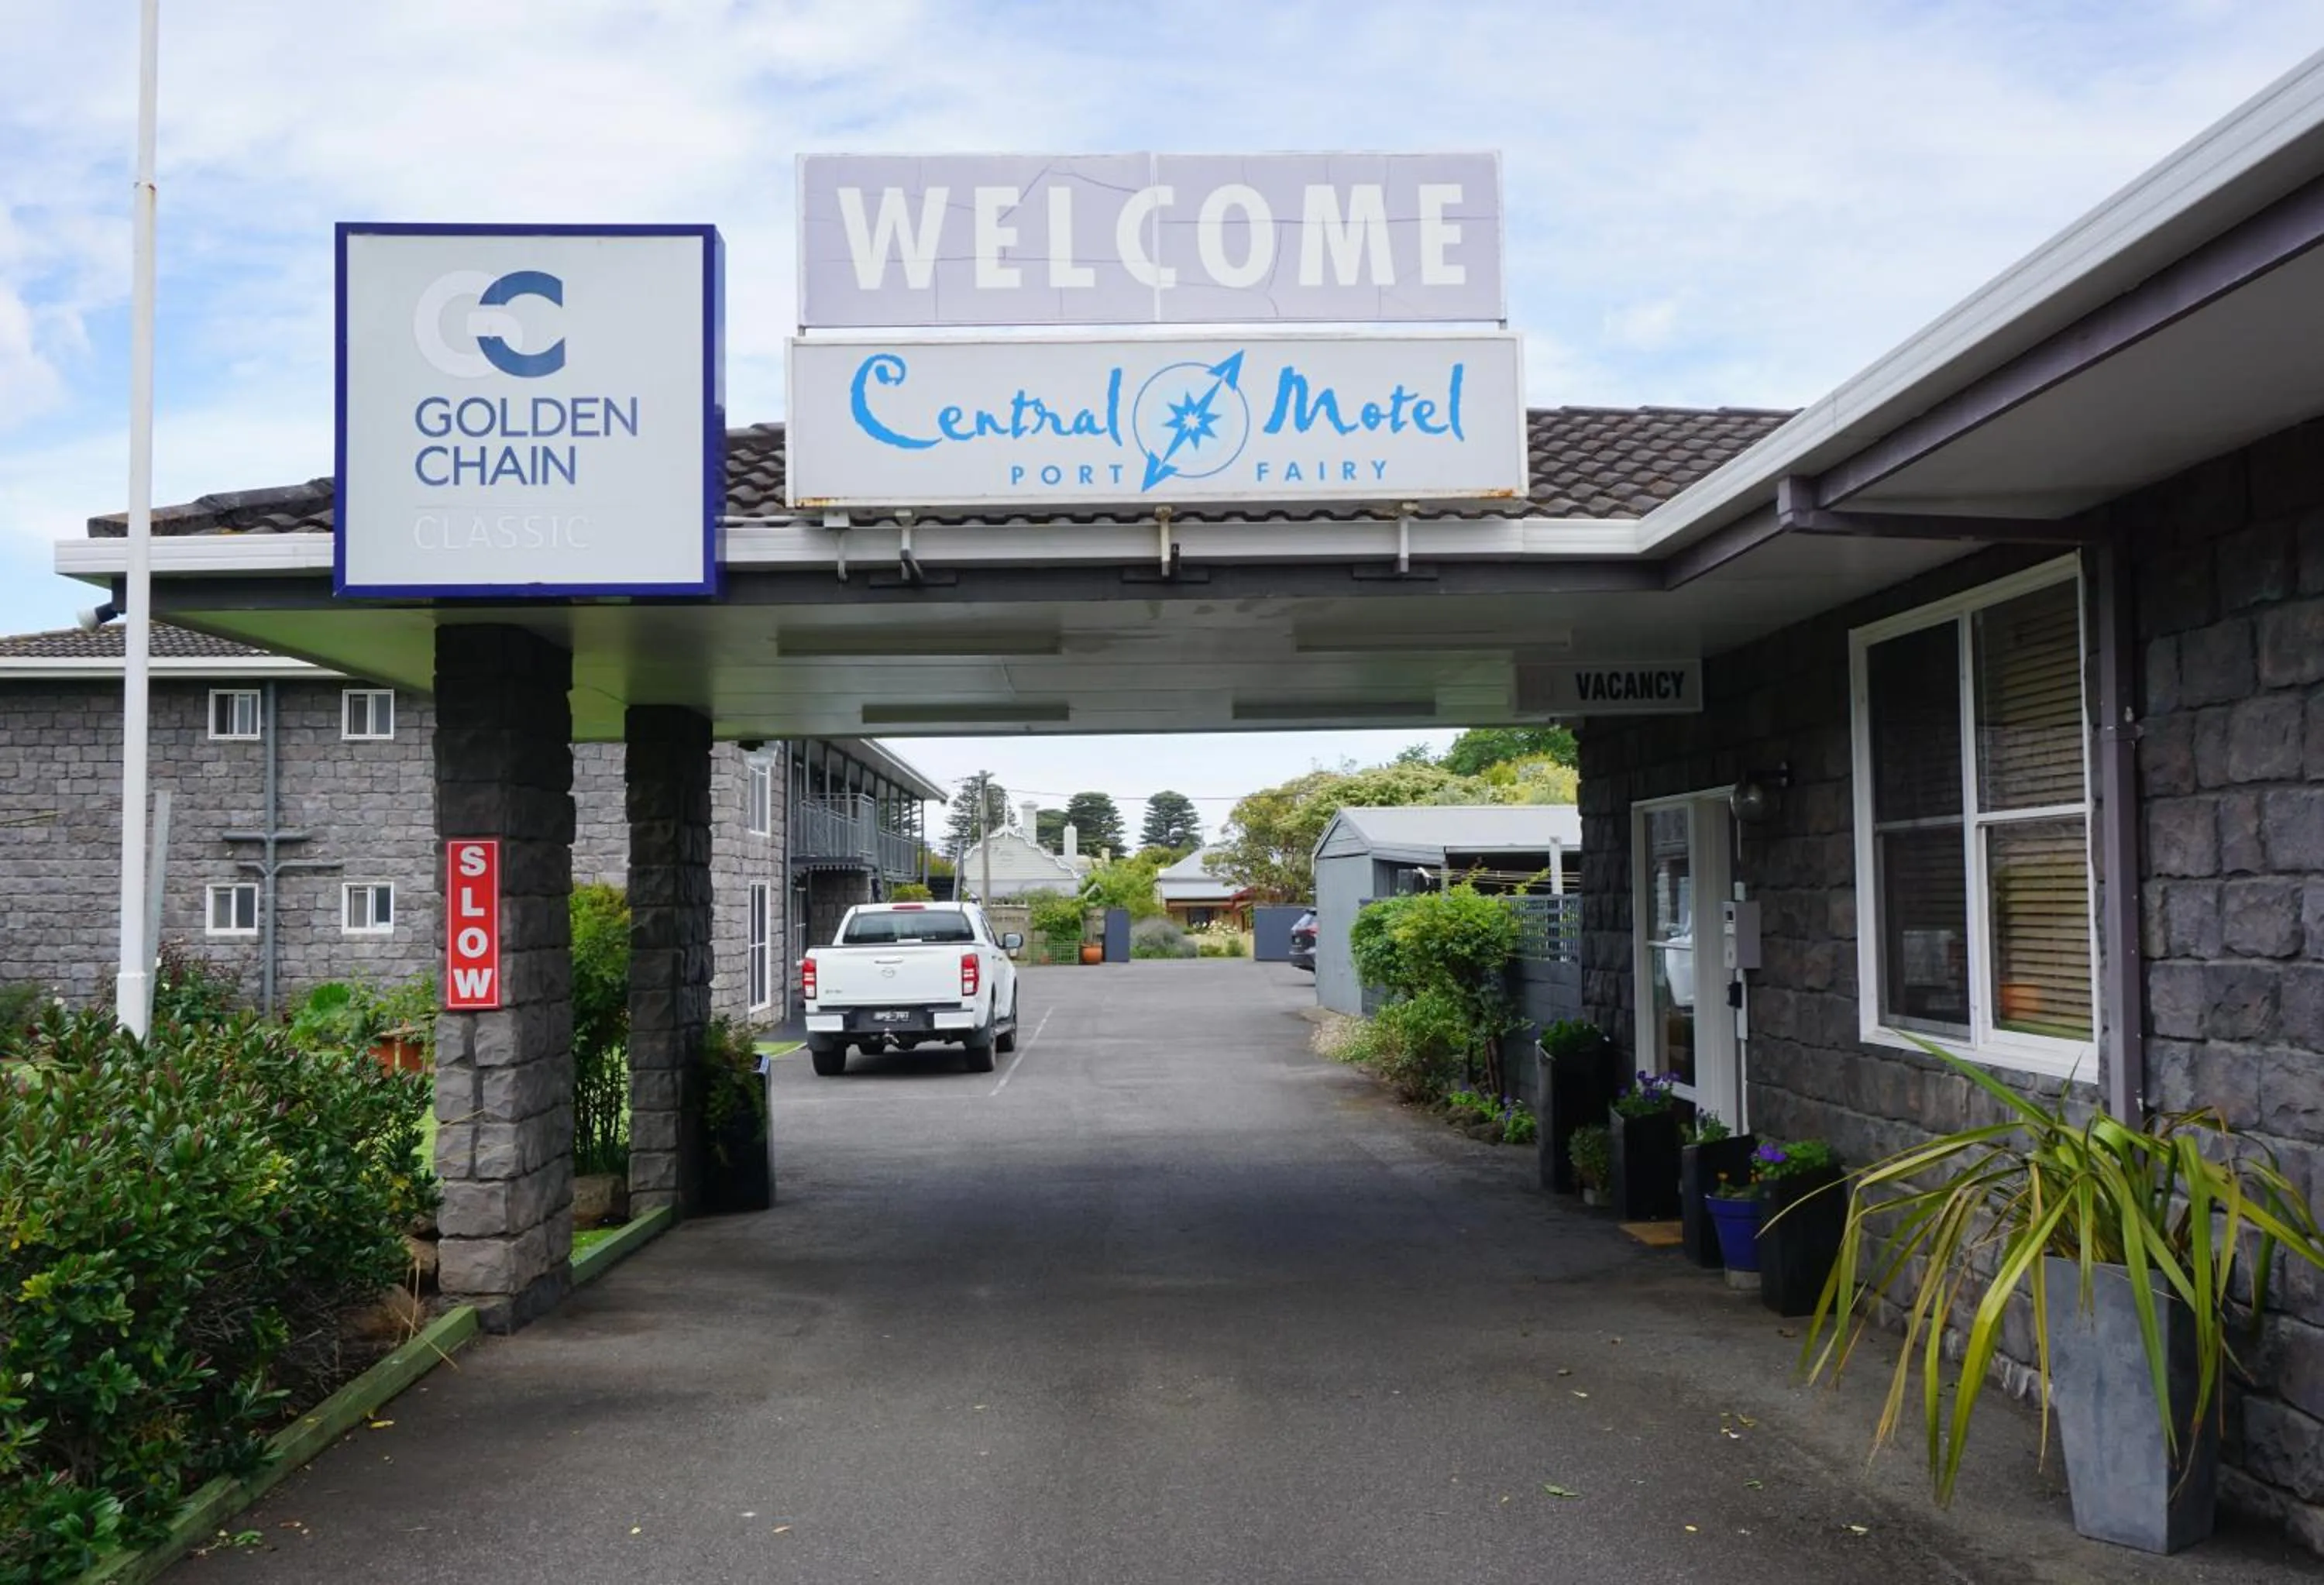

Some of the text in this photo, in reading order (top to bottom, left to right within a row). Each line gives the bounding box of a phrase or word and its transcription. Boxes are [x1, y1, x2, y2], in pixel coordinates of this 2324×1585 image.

[837, 183, 1466, 291] WELCOME
[415, 396, 638, 438] GOLDEN
[850, 353, 1466, 449] Central Motel
[415, 445, 576, 485] CHAIN
[1010, 459, 1387, 486] PORT FAIRY
[413, 514, 590, 549] CLASSIC
[1576, 671, 1685, 700] VACANCY
[453, 845, 493, 999] SLOW
